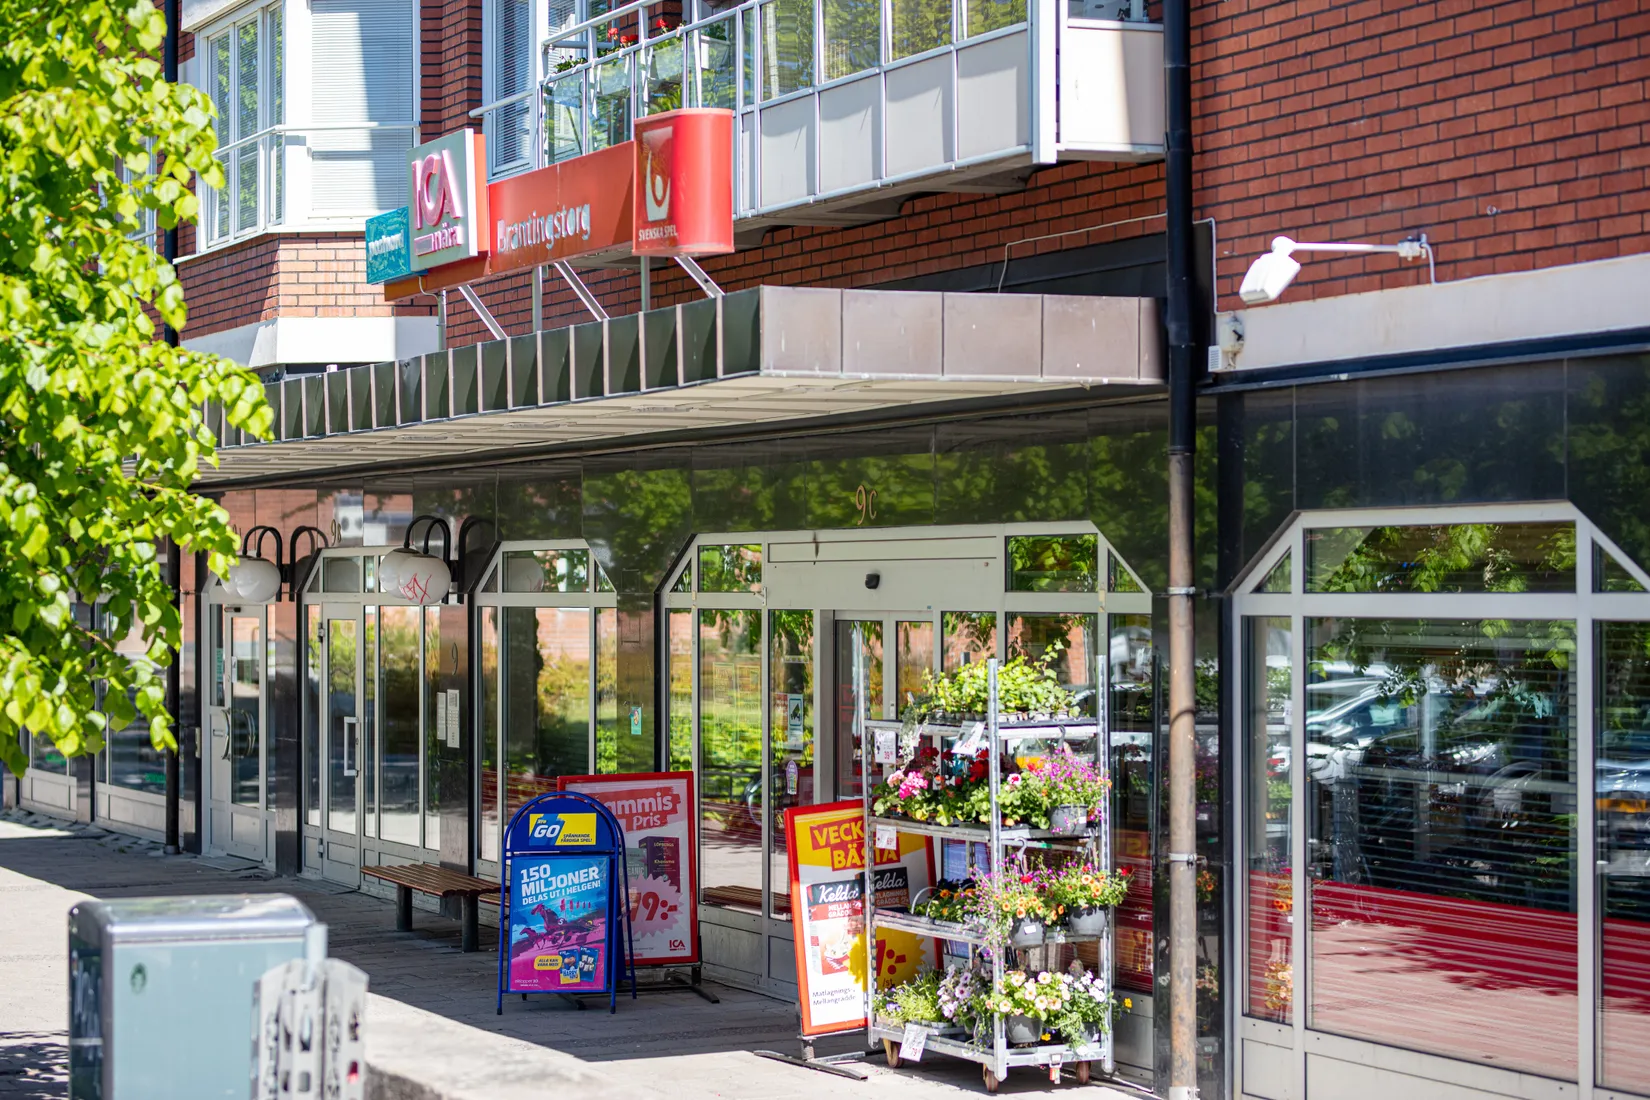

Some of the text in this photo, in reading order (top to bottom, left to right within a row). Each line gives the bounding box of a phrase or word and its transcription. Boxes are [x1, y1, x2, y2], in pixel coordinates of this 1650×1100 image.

[412, 149, 463, 230] ICA
[497, 203, 590, 254] Brantingstorg
[638, 224, 678, 242] SVENSKA SPEL
[632, 812, 661, 831] Pris
[534, 825, 561, 838] GO
[520, 864, 551, 883] 150
[521, 866, 600, 897] MILJONER
[522, 893, 549, 905] DELAS
[549, 889, 560, 898] UT
[566, 880, 601, 894] HELGEN!
[819, 884, 858, 903] Kelda
[669, 939, 686, 948] ICA
